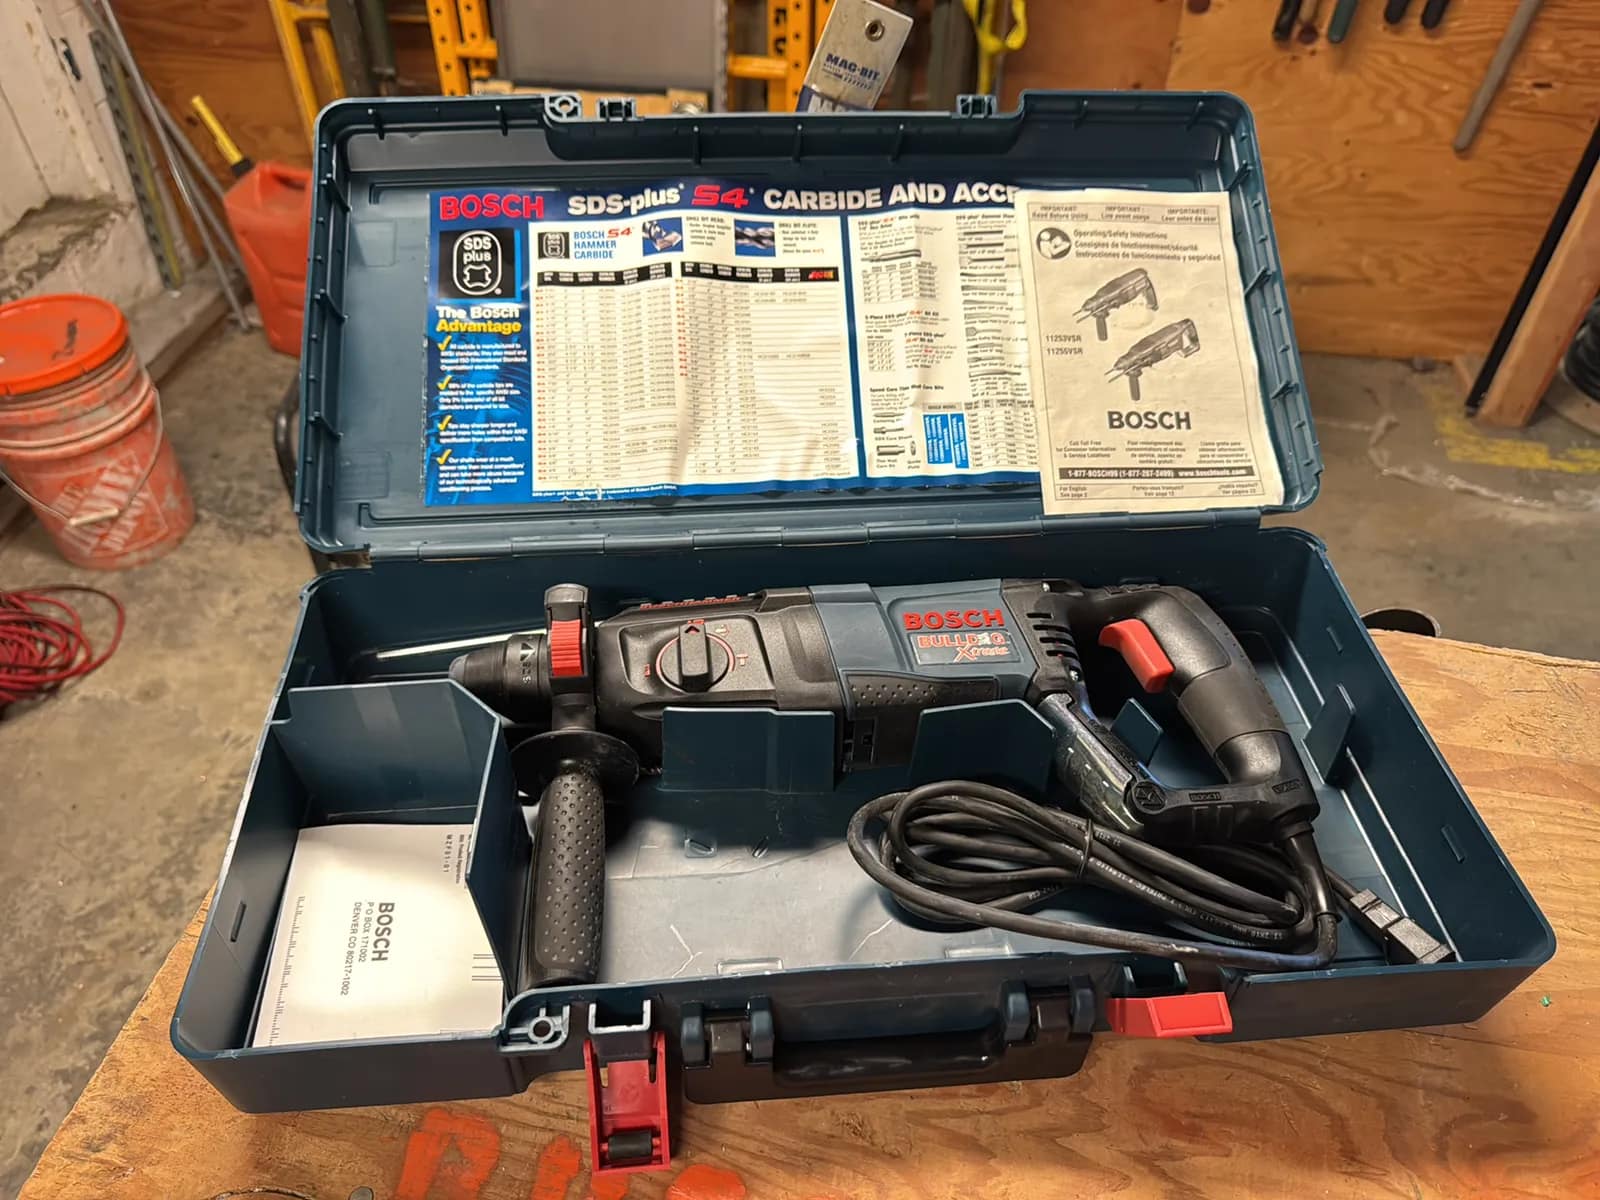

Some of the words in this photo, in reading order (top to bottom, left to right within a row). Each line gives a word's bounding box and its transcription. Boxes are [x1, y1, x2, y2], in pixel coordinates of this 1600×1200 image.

[440, 194, 544, 220] BOSCH
[568, 187, 681, 216] SDS-plus
[691, 185, 749, 208] S4
[763, 187, 882, 211] CARBIDE
[888, 181, 946, 205] AND
[573, 230, 605, 240] BOSCH
[1074, 229, 1129, 239] Operating/Safety
[463, 236, 491, 251] SDS
[573, 240, 617, 250] HAMMER
[463, 250, 491, 264] plus
[573, 250, 614, 260] CARBIDE
[1076, 250, 1120, 258] Instrucciones
[1188, 254, 1220, 262] seguridad
[436, 305, 467, 319] The
[470, 305, 520, 319] Bosch
[436, 319, 522, 335] Advantage
[1107, 410, 1191, 430] BOSCH
[903, 609, 1005, 630] BOSCH
[349, 902, 362, 935] DENVER
[363, 917, 373, 933] BOX
[371, 902, 396, 962] BOSCH
[347, 936, 357, 949] CO
[358, 936, 369, 963] 171002
[340, 950, 355, 996] 80217-1002
